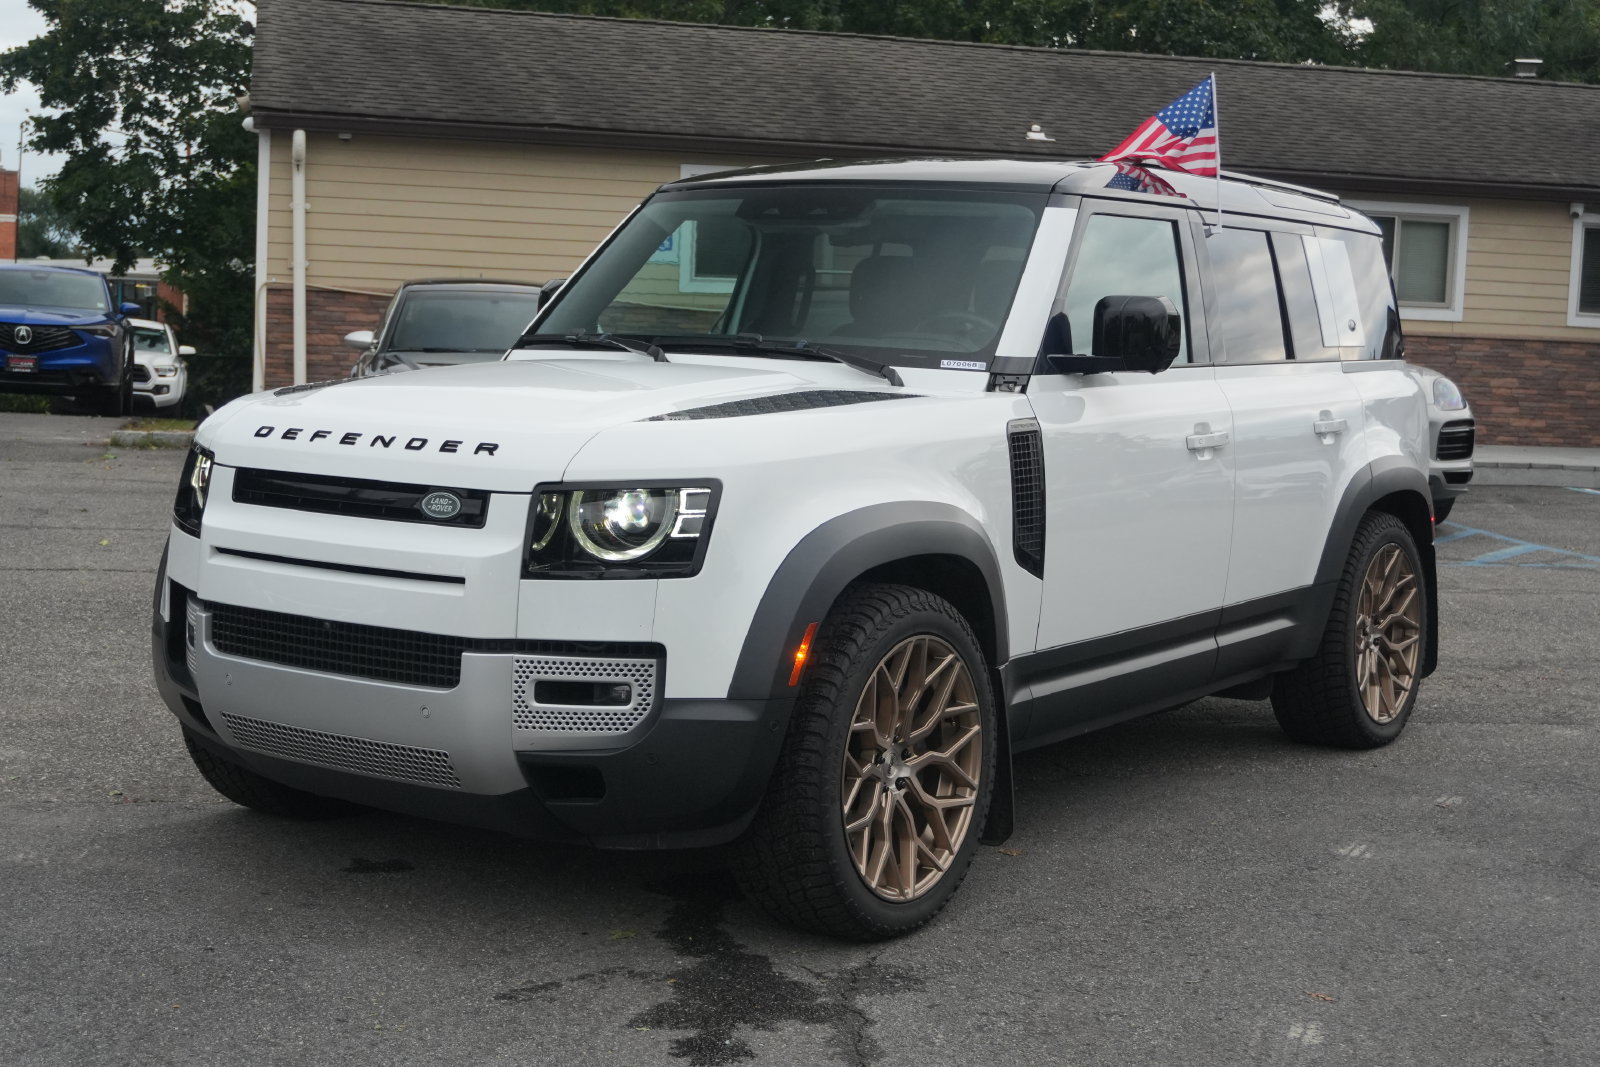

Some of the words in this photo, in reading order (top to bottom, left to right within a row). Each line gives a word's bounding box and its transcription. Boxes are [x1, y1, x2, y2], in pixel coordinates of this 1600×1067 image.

[253, 425, 500, 456] DEFENDER
[430, 497, 449, 505] LAND
[430, 504, 453, 512] ROVER
